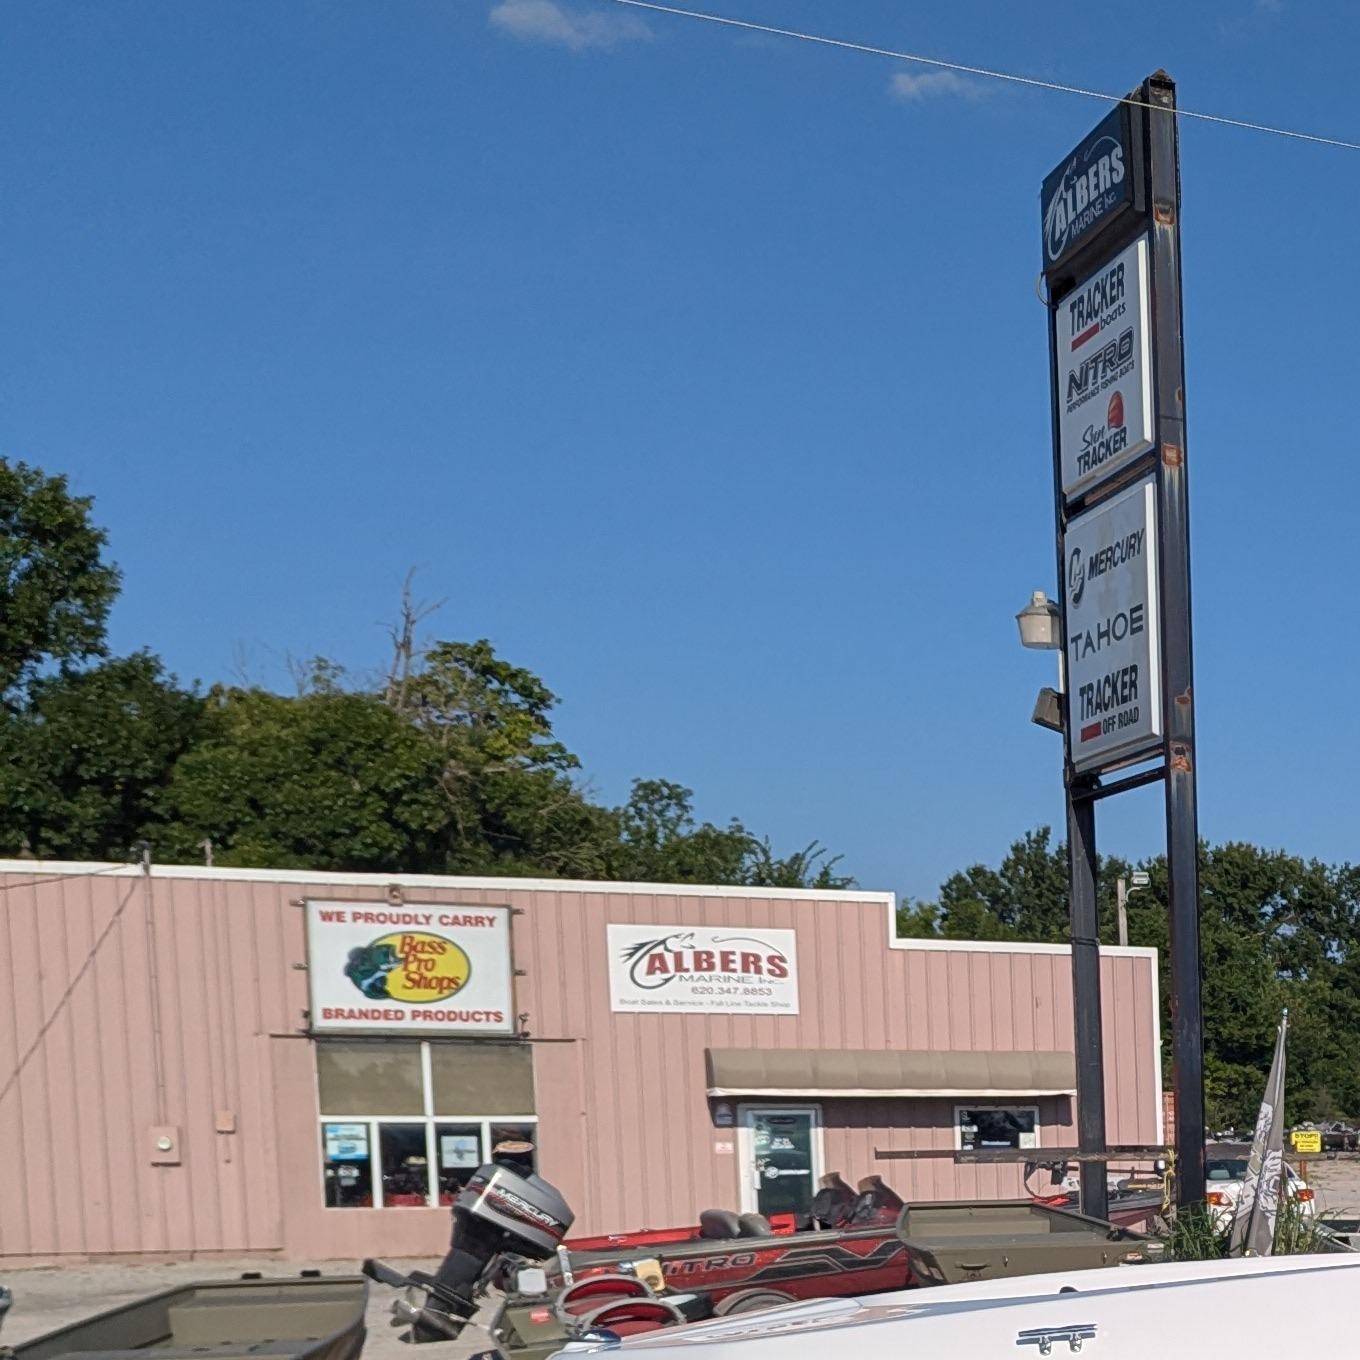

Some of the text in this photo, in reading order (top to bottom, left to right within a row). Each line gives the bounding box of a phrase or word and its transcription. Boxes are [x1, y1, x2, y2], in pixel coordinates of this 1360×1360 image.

[1055, 145, 1124, 240] ALBERS
[1071, 197, 1103, 239] MARINE
[1070, 262, 1125, 336] TRACKER
[1100, 302, 1126, 331] boats
[1067, 326, 1134, 404] NITRO
[1077, 426, 1128, 476] TRACKER
[1080, 424, 1105, 452] Sun
[1088, 528, 1144, 580] MERCURY
[1071, 603, 1144, 661] TAHOE
[1079, 664, 1138, 721] TRACKER
[1102, 706, 1140, 735] OFF ROAD
[319, 910, 497, 928] WE PROUDLY CARRY
[399, 934, 449, 955] Bass
[401, 952, 437, 972] Pro
[645, 950, 789, 979] ALBERS
[402, 970, 461, 993] Shops
[678, 974, 754, 985] MARINE
[322, 1008, 504, 1023] BRANDED PRODUCTS
